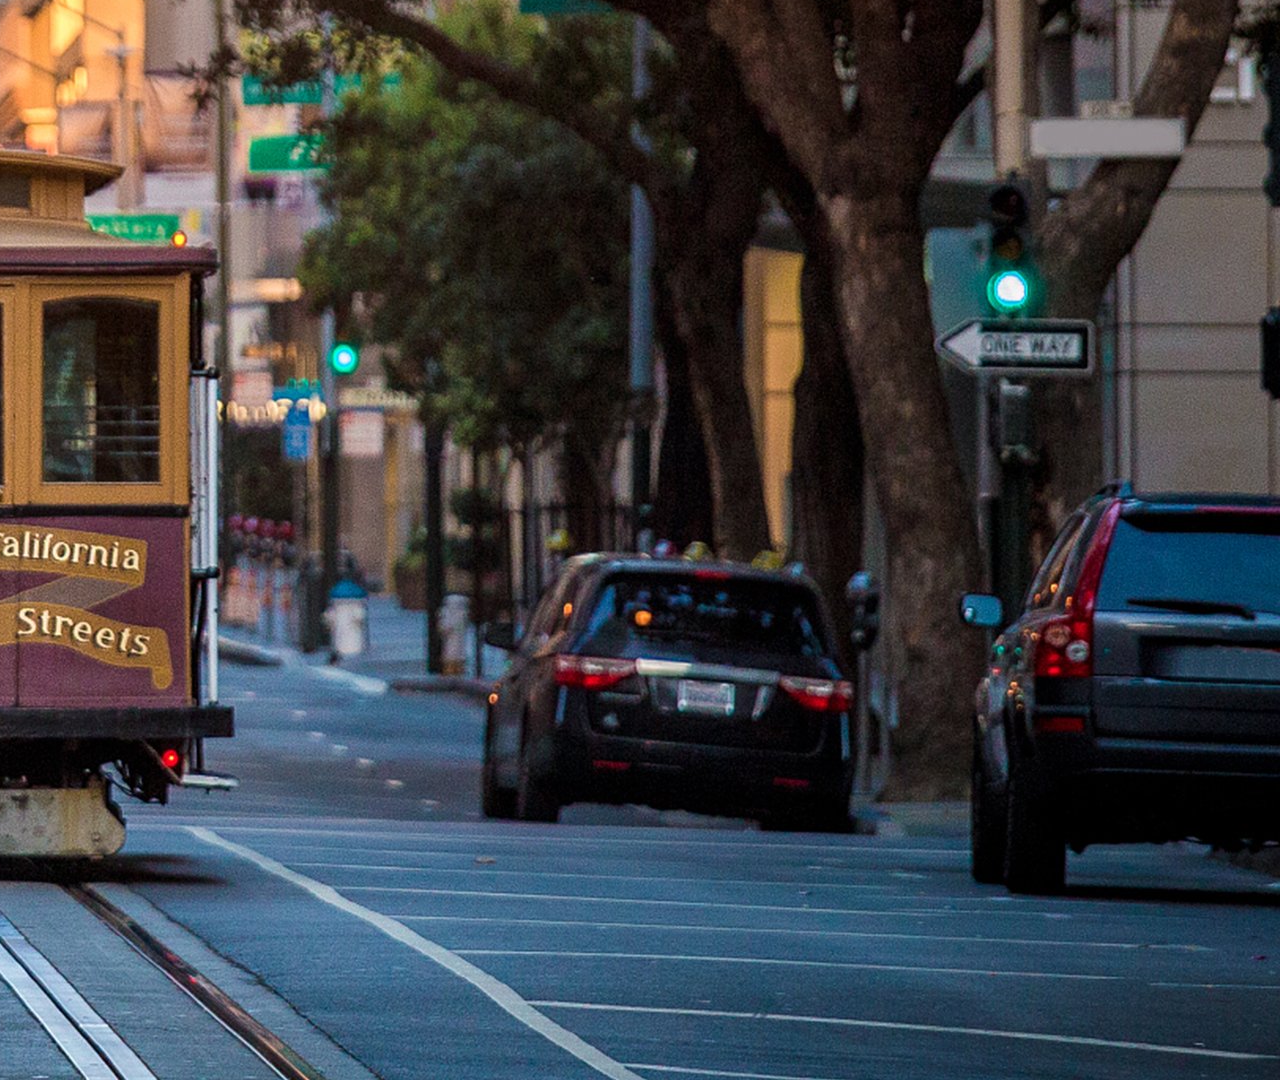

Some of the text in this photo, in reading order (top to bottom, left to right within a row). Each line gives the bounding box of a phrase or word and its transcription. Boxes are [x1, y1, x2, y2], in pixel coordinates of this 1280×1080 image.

[981, 333, 1073, 354] ONE WAY
[16, 607, 151, 656] Streets
